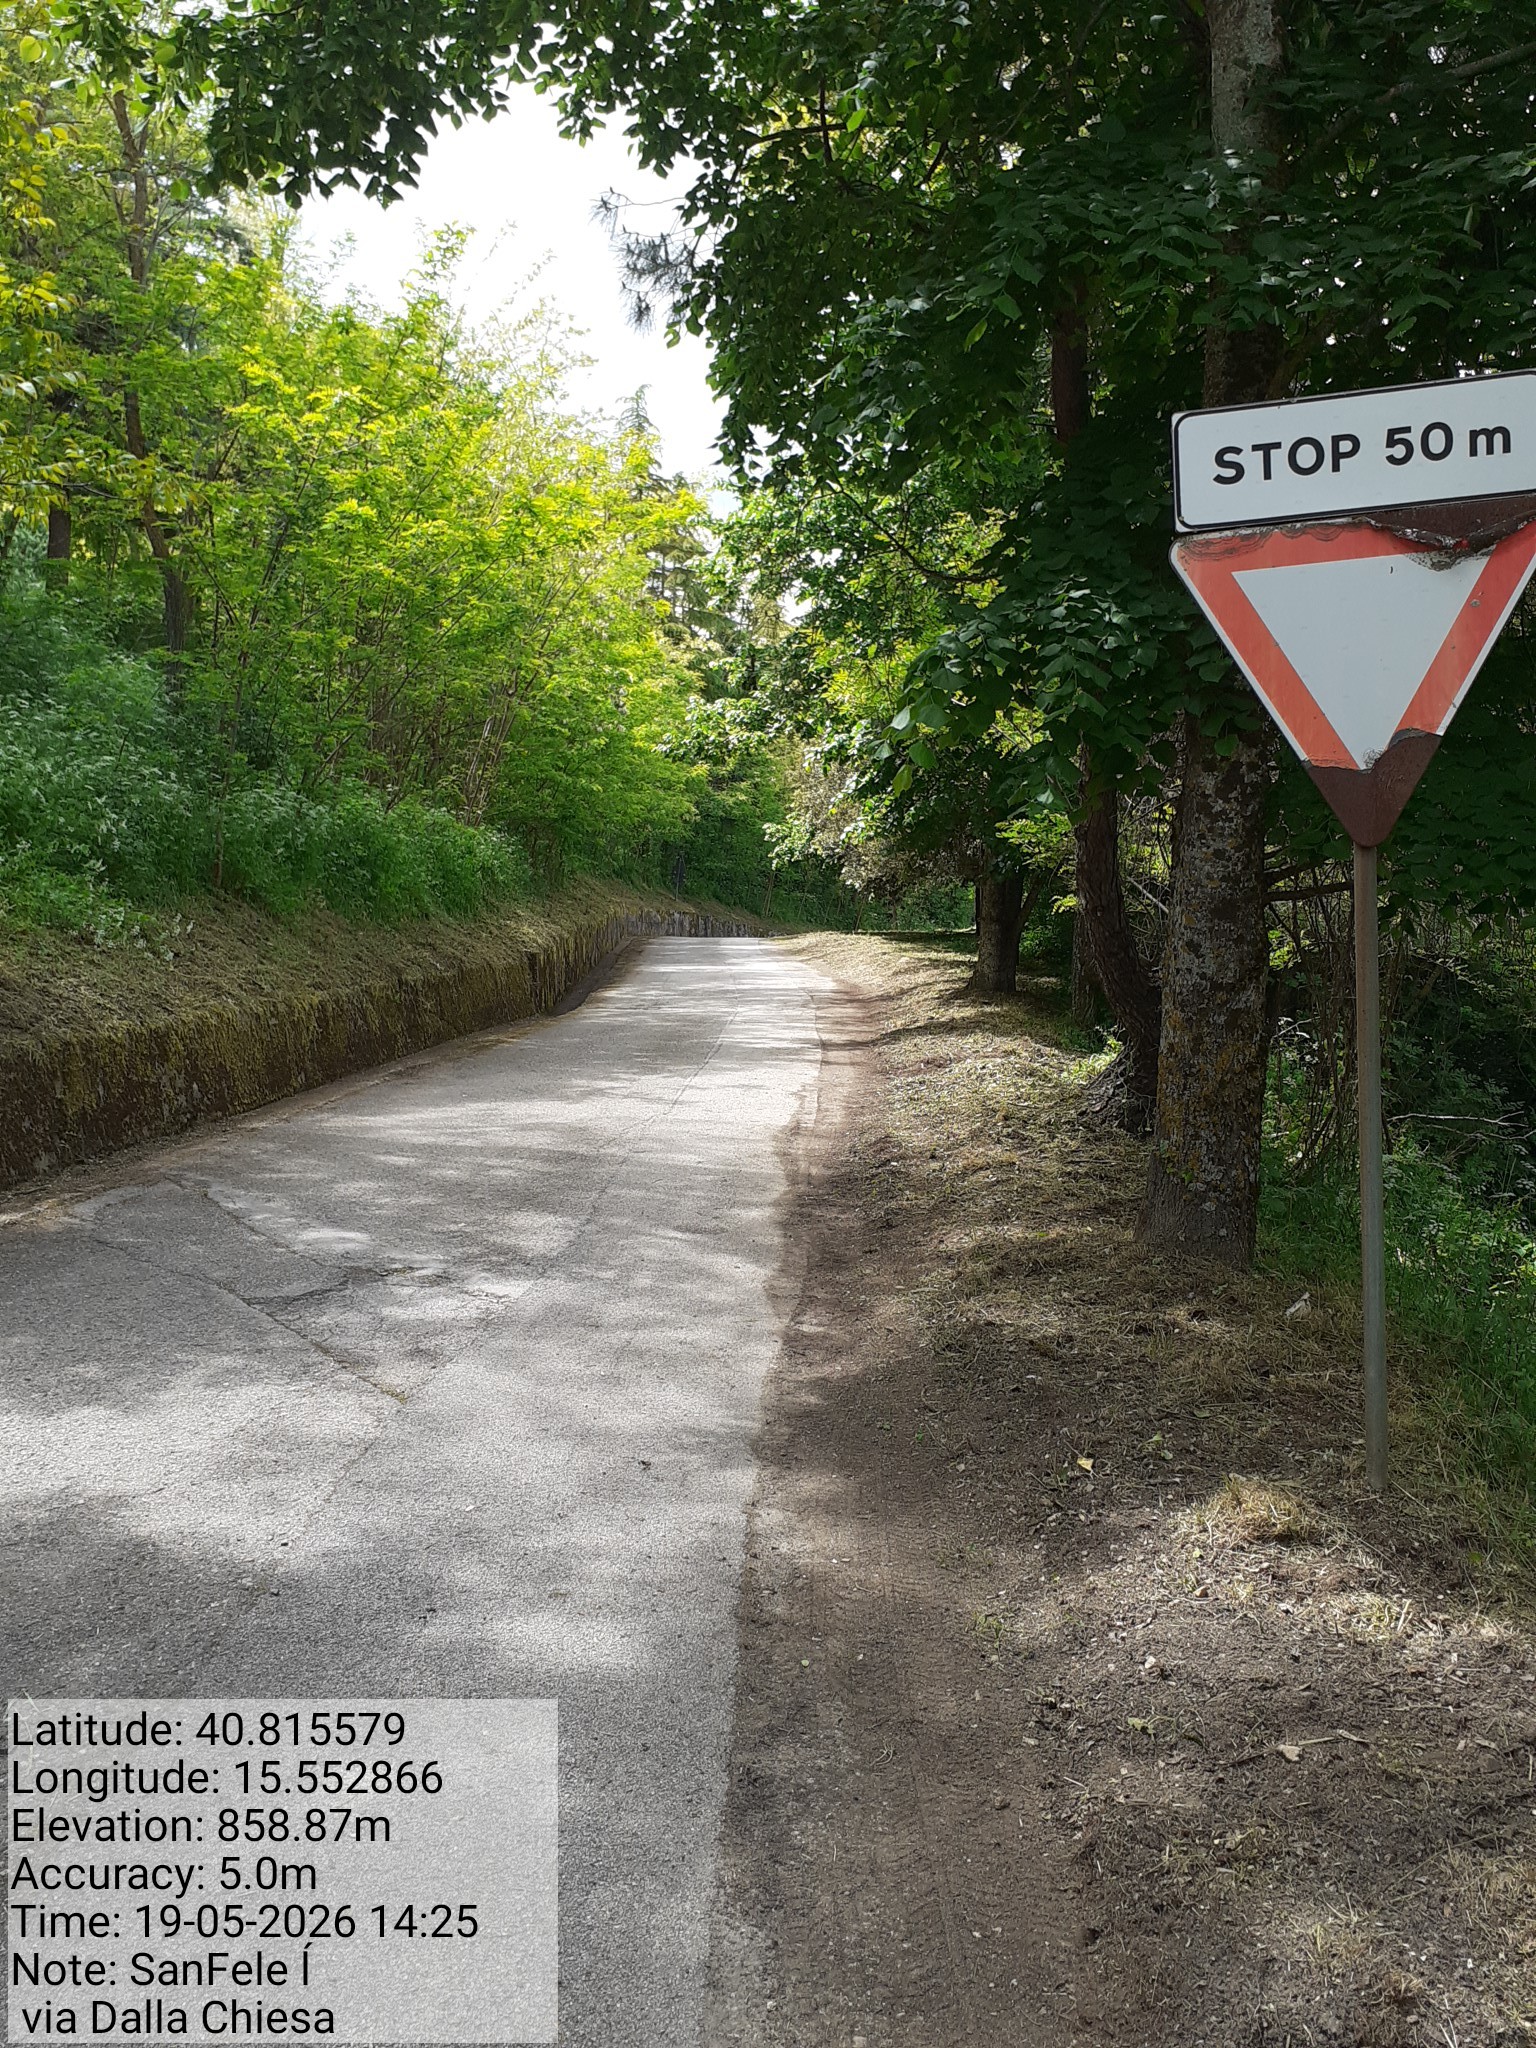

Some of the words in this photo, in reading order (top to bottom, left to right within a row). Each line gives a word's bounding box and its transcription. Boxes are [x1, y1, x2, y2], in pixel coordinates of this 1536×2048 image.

[1213, 434, 1360, 484] STOP
[1386, 422, 1453, 465] 50
[1470, 426, 1511, 457] m
